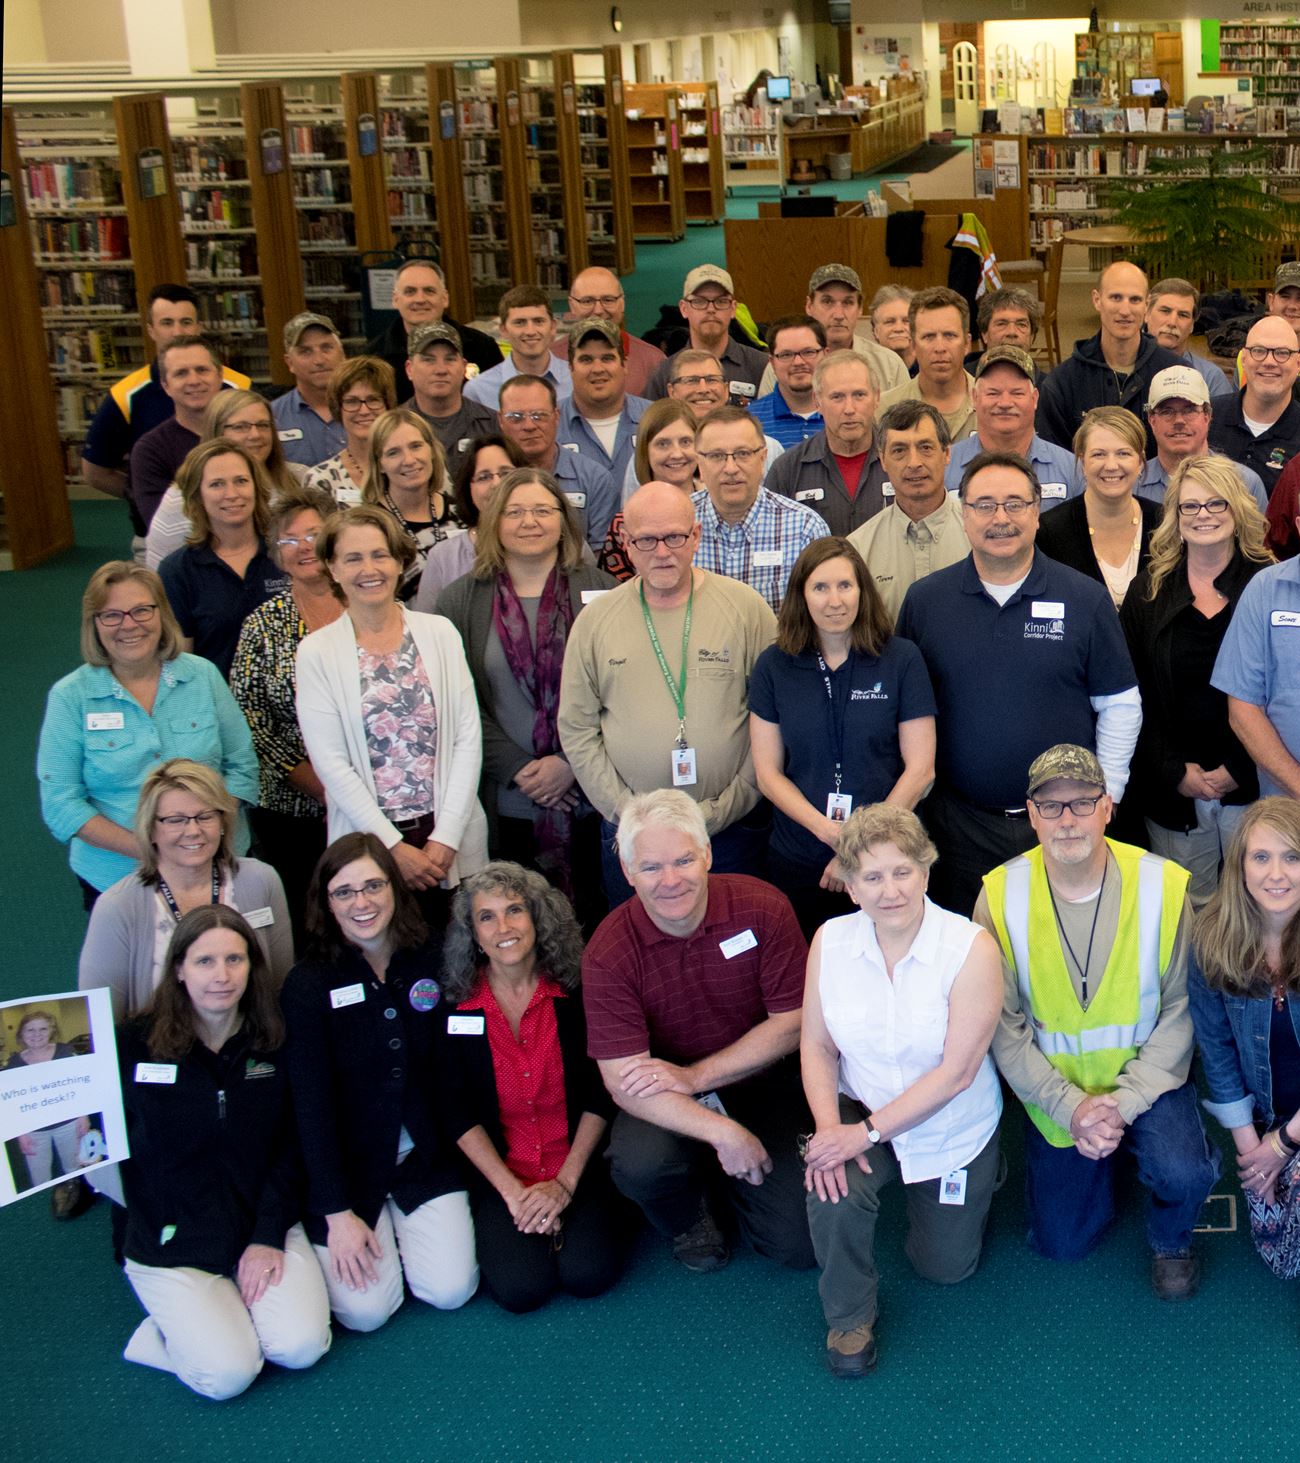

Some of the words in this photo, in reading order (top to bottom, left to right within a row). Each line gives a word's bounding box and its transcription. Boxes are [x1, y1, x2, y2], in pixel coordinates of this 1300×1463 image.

[1244, 2, 1271, 11] AREA
[1024, 622, 1048, 633] Kinni
[160, 882, 174, 905] FALLS
[1, 1087, 27, 1101] Who
[42, 1075, 91, 1091] watching
[20, 1102, 38, 1113] the
[41, 1091, 76, 1107] desk!?
